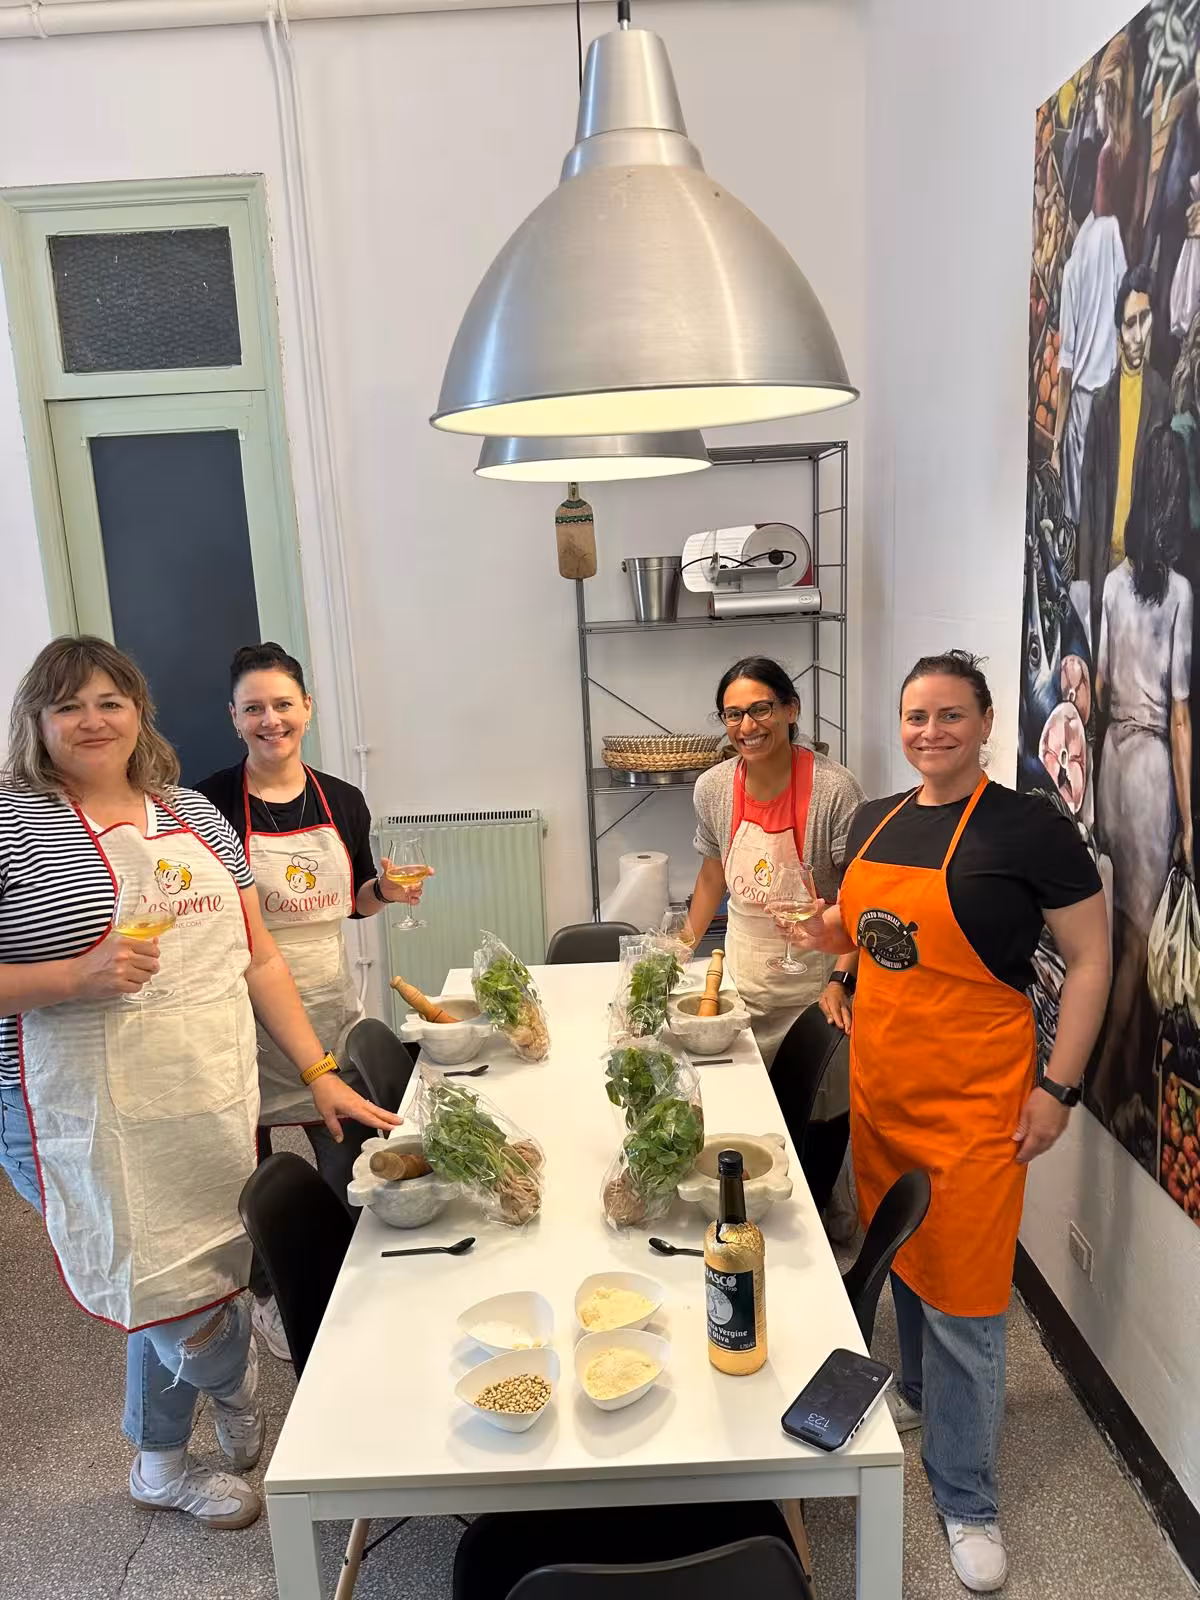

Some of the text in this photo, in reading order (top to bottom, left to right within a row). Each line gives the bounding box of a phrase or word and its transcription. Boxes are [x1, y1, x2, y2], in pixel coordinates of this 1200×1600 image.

[732, 875, 767, 904] Cesa
[264, 890, 340, 913] Cesarine
[712, 1330, 730, 1343] Oliva
[718, 1327, 748, 1339] Vergine
[807, 1412, 830, 1428] 1:23
